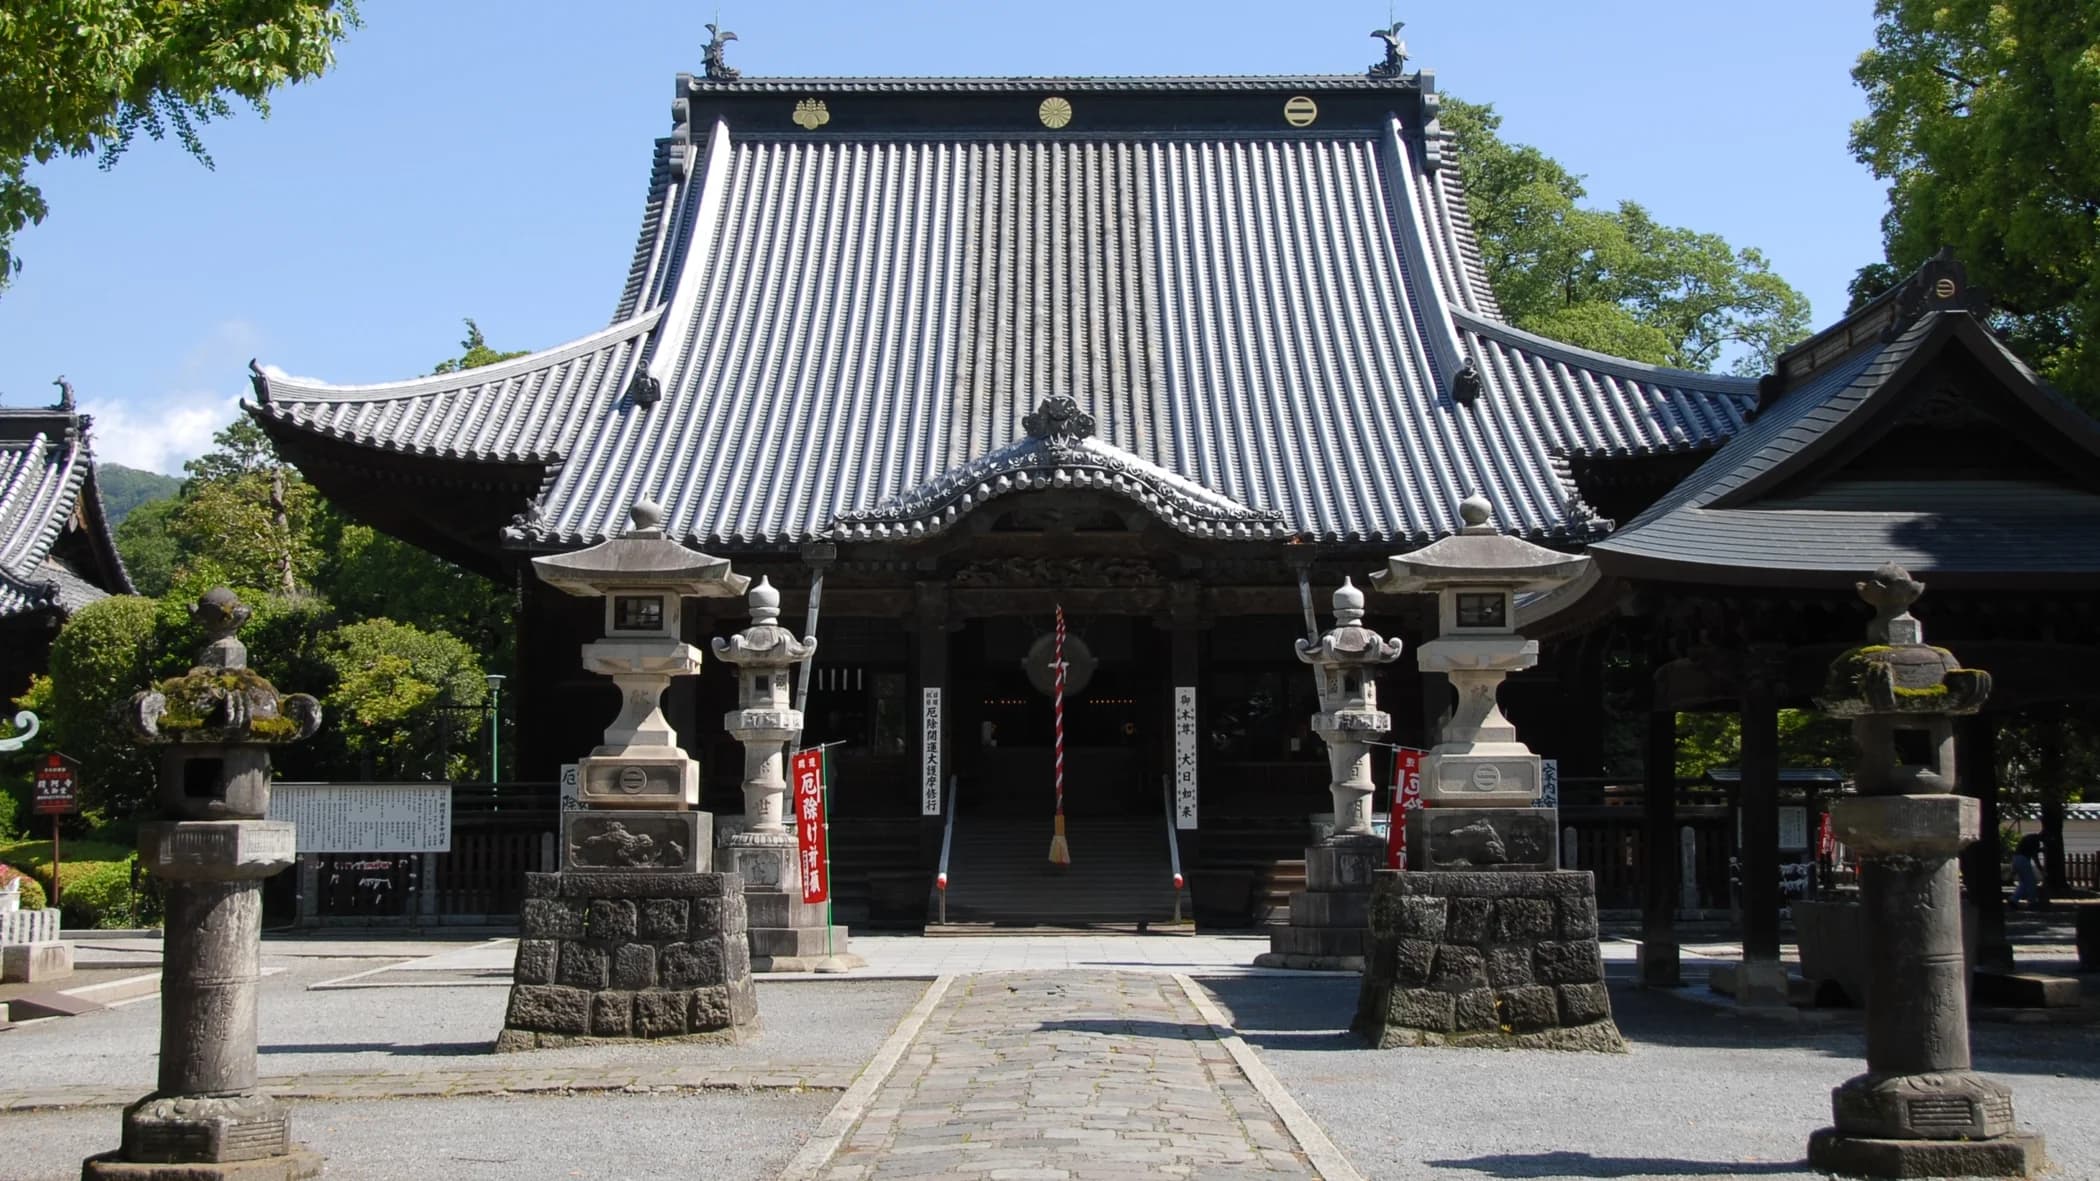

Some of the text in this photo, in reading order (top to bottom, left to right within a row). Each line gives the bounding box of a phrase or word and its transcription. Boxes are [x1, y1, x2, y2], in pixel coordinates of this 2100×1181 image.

[1182, 753, 1192, 818] 大日如来
[801, 772, 820, 893] 厄除け祈願
